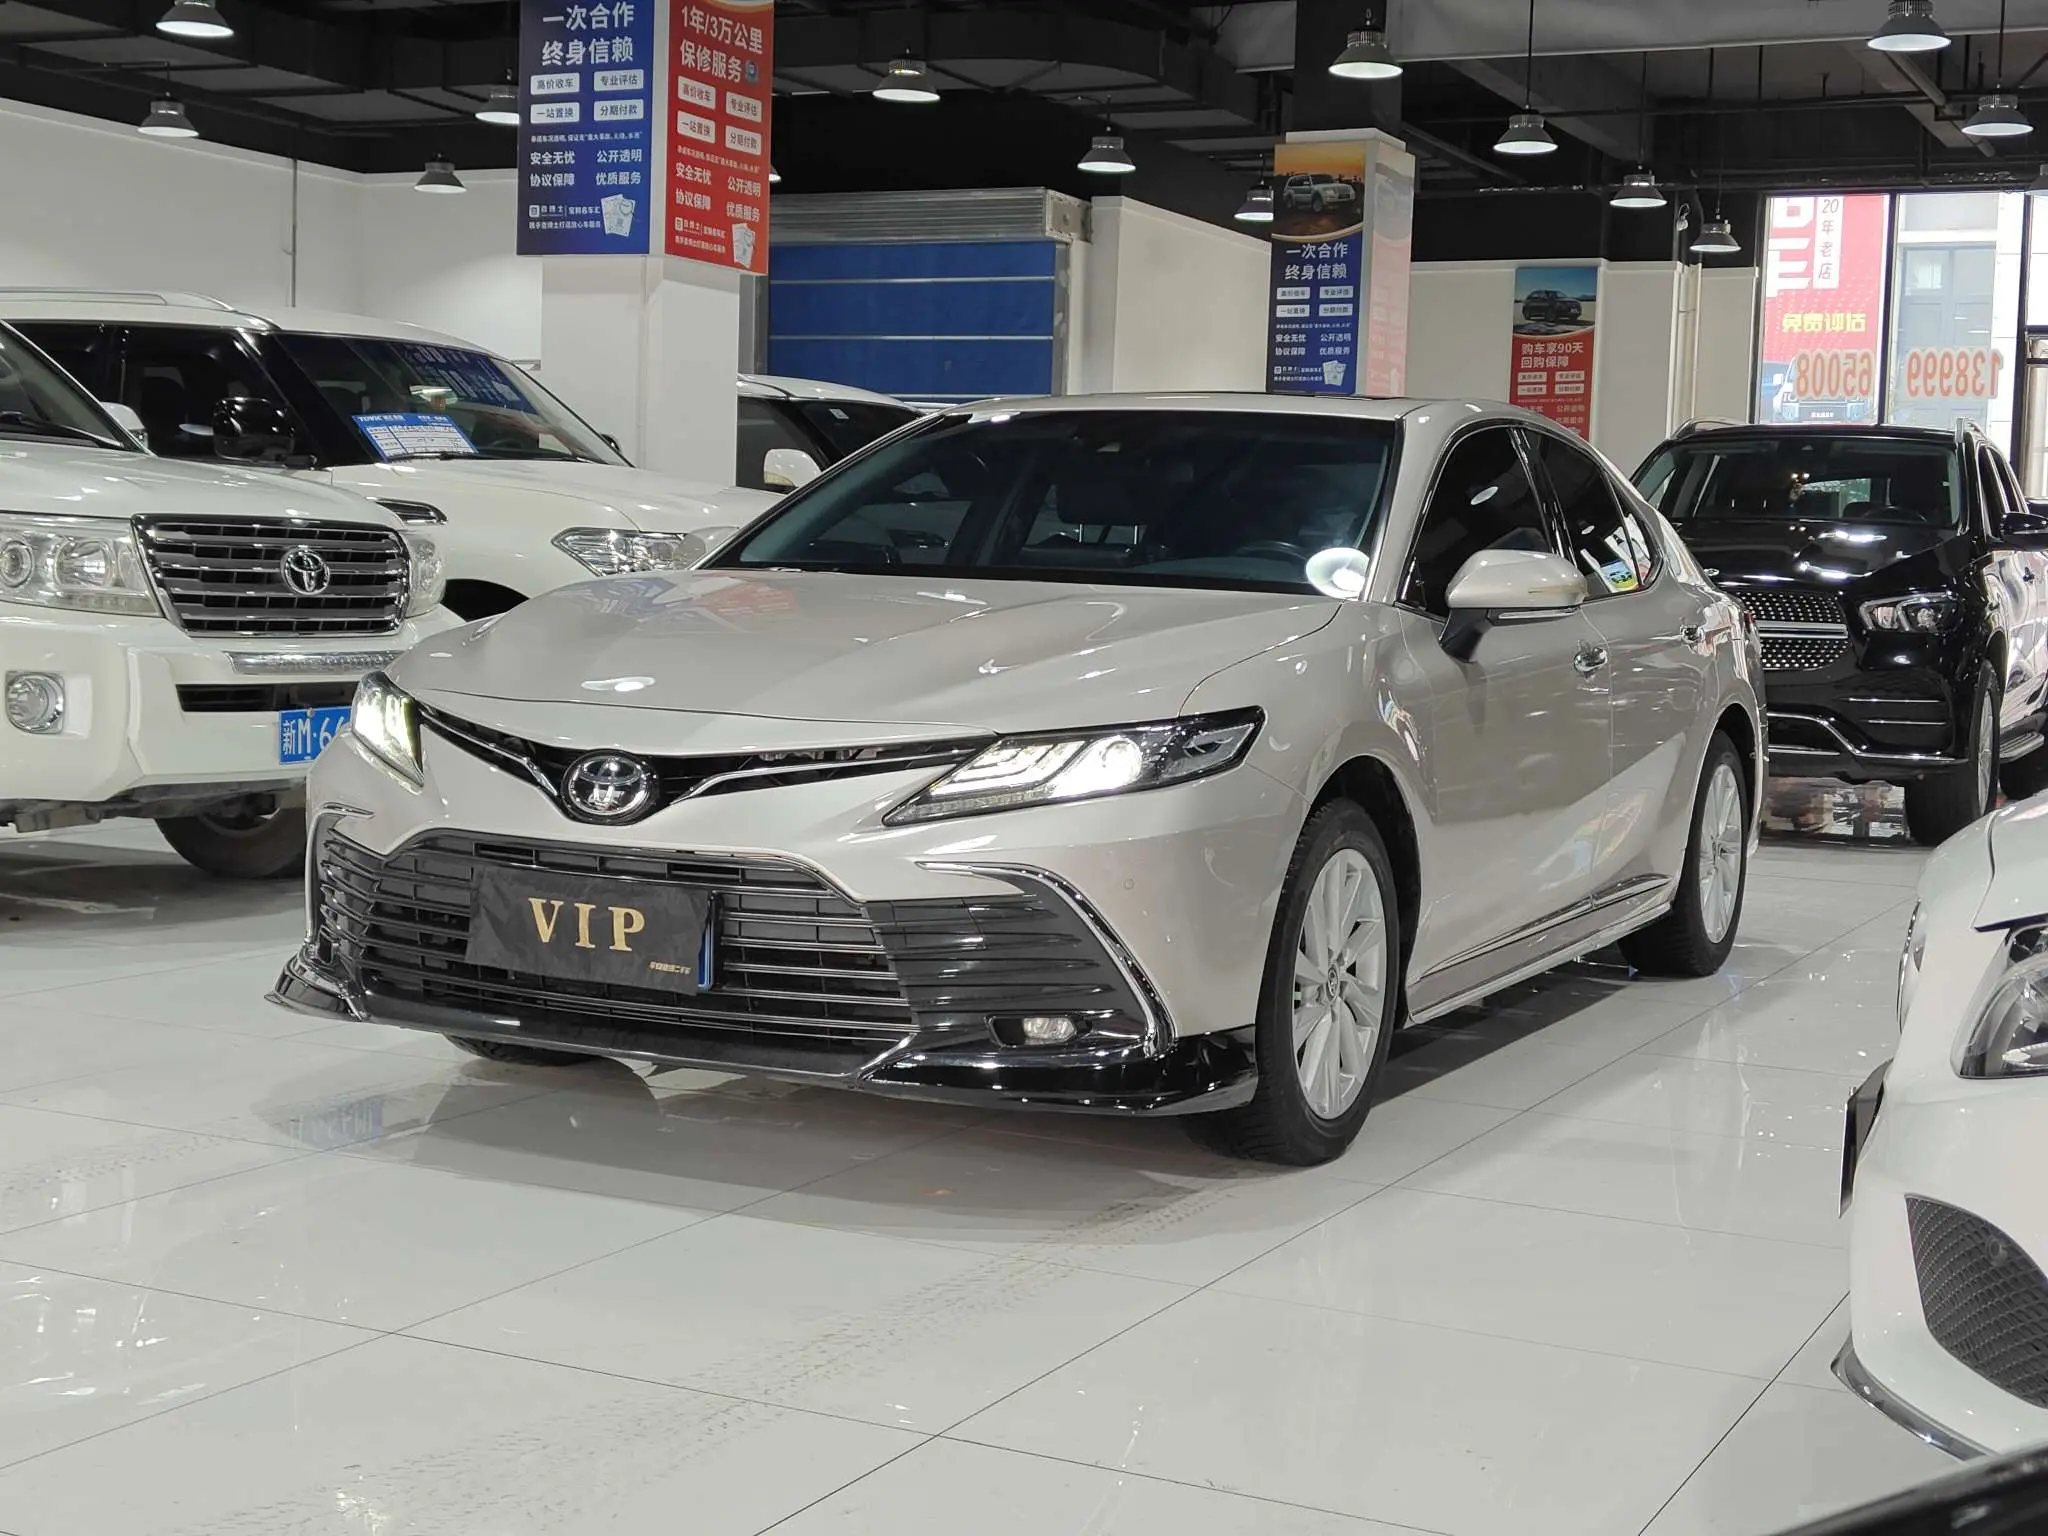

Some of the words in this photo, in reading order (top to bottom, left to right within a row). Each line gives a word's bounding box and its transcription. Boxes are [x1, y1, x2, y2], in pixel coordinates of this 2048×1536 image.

[543, 3, 635, 31] 一次合作
[681, 6, 764, 54] 1年/3万公里
[541, 36, 634, 66] 终身信赖
[680, 40, 742, 83] 保修服务
[537, 78, 574, 90] 高价收车
[600, 73, 638, 86] 专业评估
[537, 107, 574, 120] 一站置换
[600, 103, 638, 116] 分期付款
[530, 151, 575, 165] 安全无忧
[597, 149, 642, 162] 公开透明
[530, 173, 575, 187] 协议保障
[596, 171, 641, 185] 优质服务
[676, 162, 712, 185] 安全无忧
[728, 176, 761, 198] 公开透明
[676, 188, 711, 210] 协议保障
[726, 202, 760, 222] 优质服务
[1818, 199, 1840, 280] 20年老店
[1286, 242, 1349, 259] 一次合作
[1284, 263, 1347, 280] 终身信赖
[1521, 342, 1584, 355] 购车享90天
[1521, 355, 1569, 368] 回购保障
[283, 717, 344, 755] 新M·6
[528, 897, 645, 952] VIP
